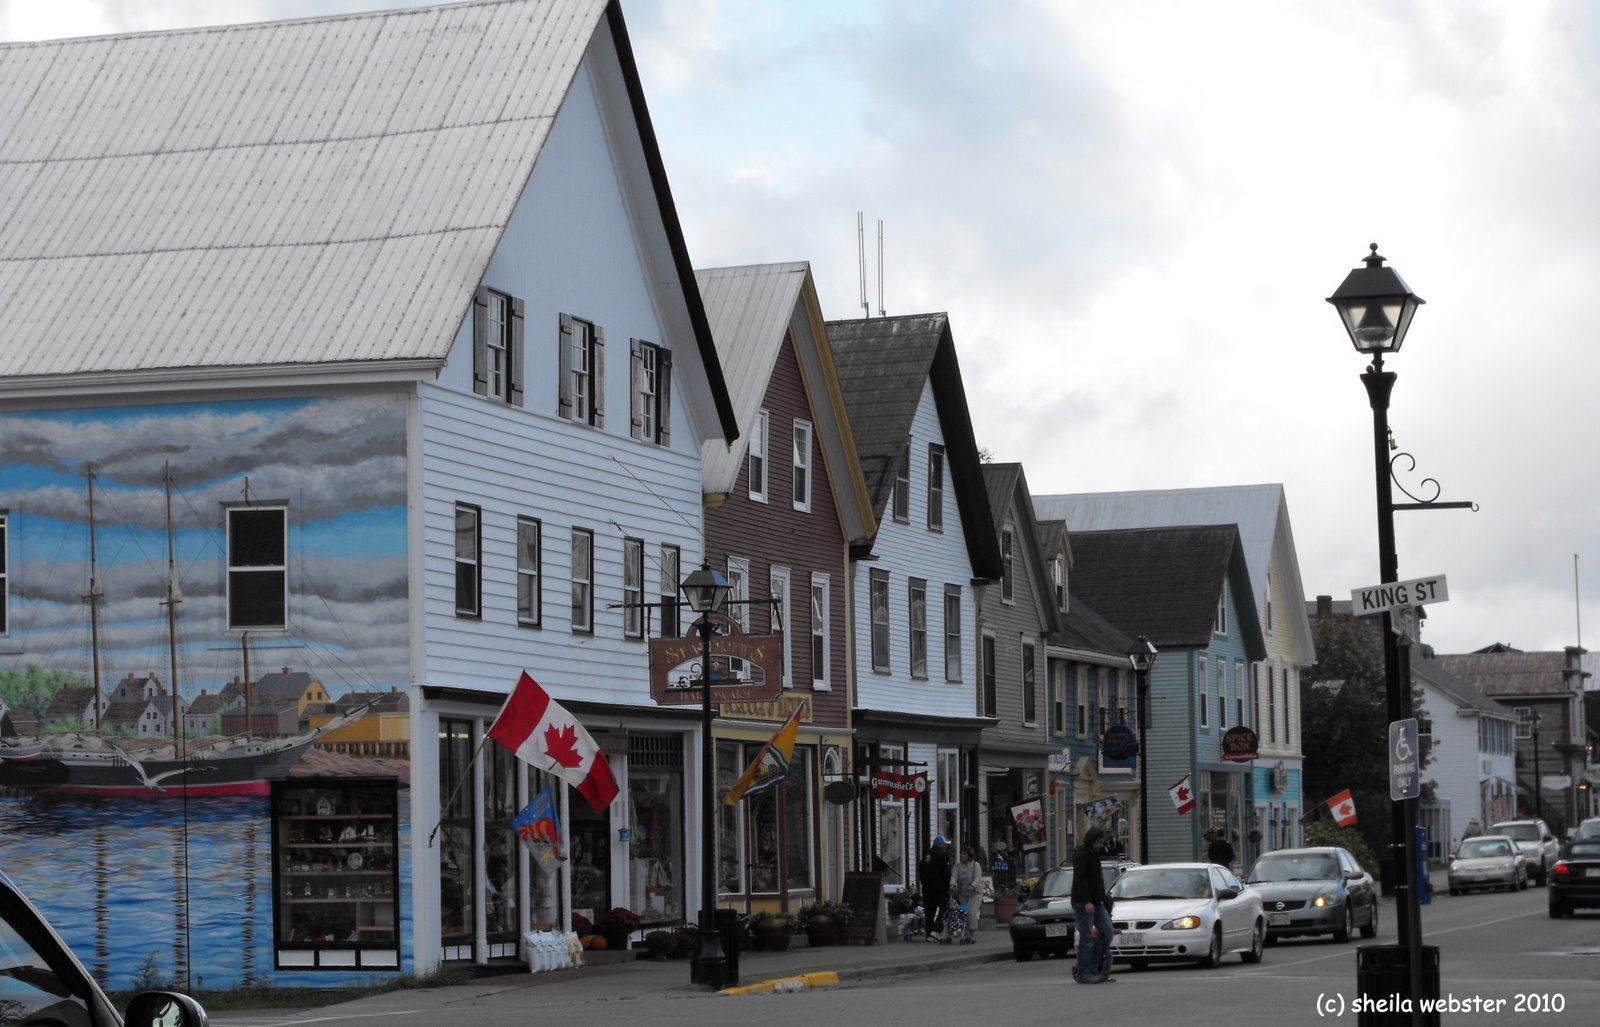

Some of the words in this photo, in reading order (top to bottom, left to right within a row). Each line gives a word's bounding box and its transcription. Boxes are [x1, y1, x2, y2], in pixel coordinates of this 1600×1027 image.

[1362, 585, 1409, 610] KING
[1415, 580, 1437, 601] ST
[665, 646, 687, 665] ST
[680, 689, 751, 702] HARWARE
[1226, 733, 1255, 743] SPICE
[1230, 743, 1251, 751] BOX
[1393, 762, 1416, 776] PARKING
[1397, 776, 1412, 788] ONLY
